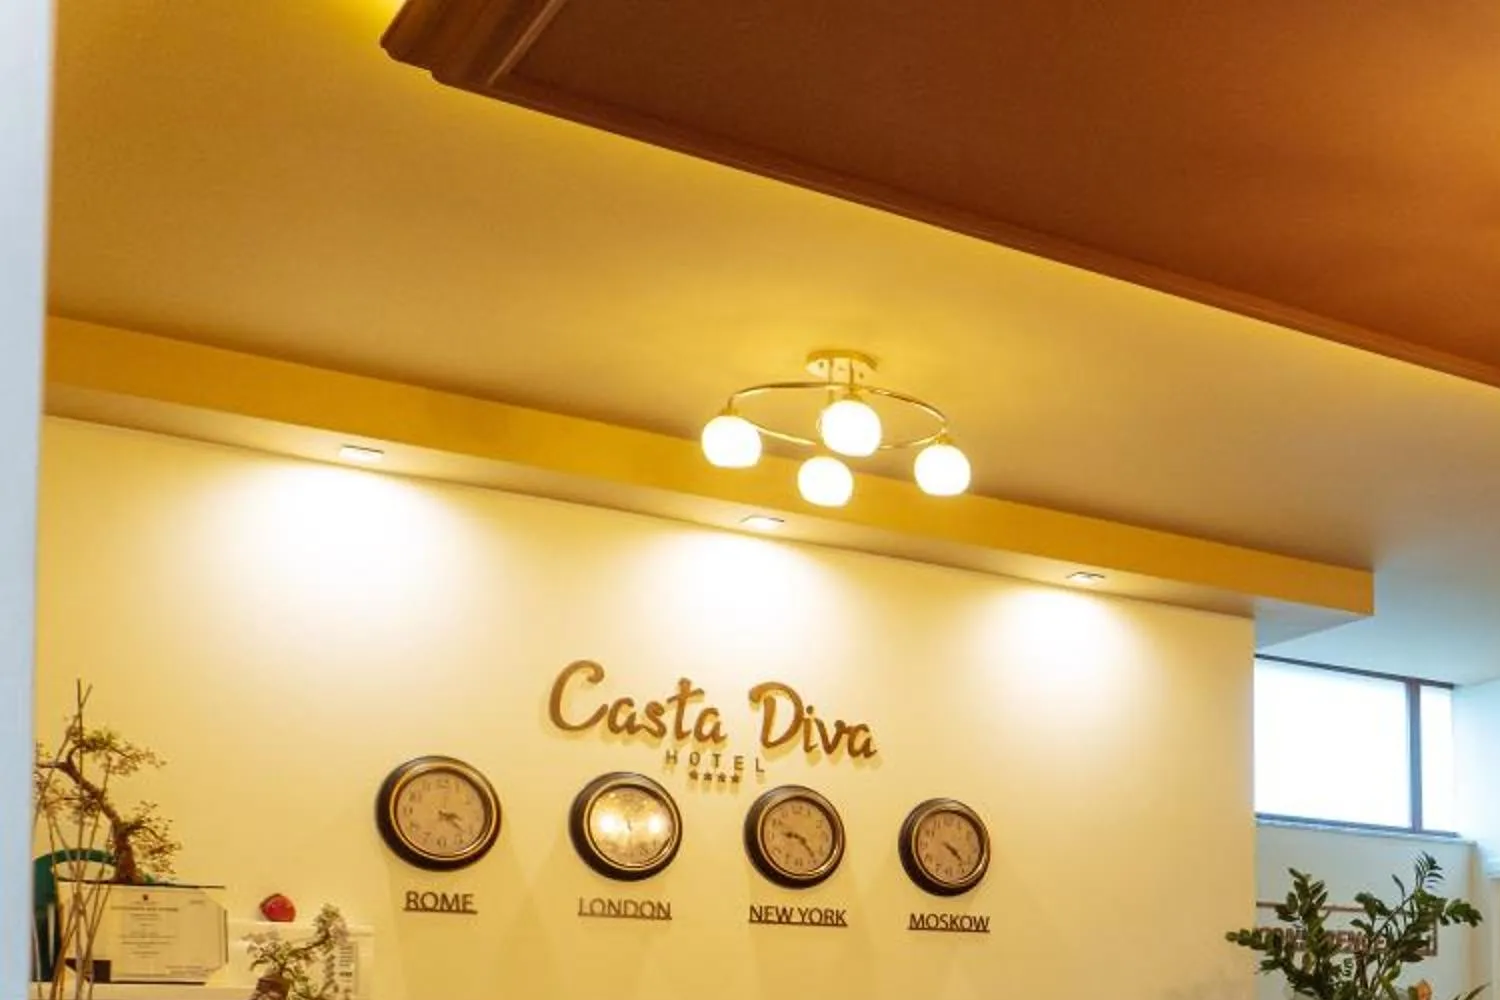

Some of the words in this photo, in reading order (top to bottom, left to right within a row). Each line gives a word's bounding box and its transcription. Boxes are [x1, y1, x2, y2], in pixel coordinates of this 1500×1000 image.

[549, 660, 727, 743] Casta
[748, 682, 877, 758] Diva
[665, 749, 765, 773] HOTEL
[404, 891, 476, 913] ROME
[578, 896, 671, 919] LONDON
[748, 905, 793, 924] NEW
[796, 907, 848, 926] YORK
[909, 913, 991, 932] MOSKOW
